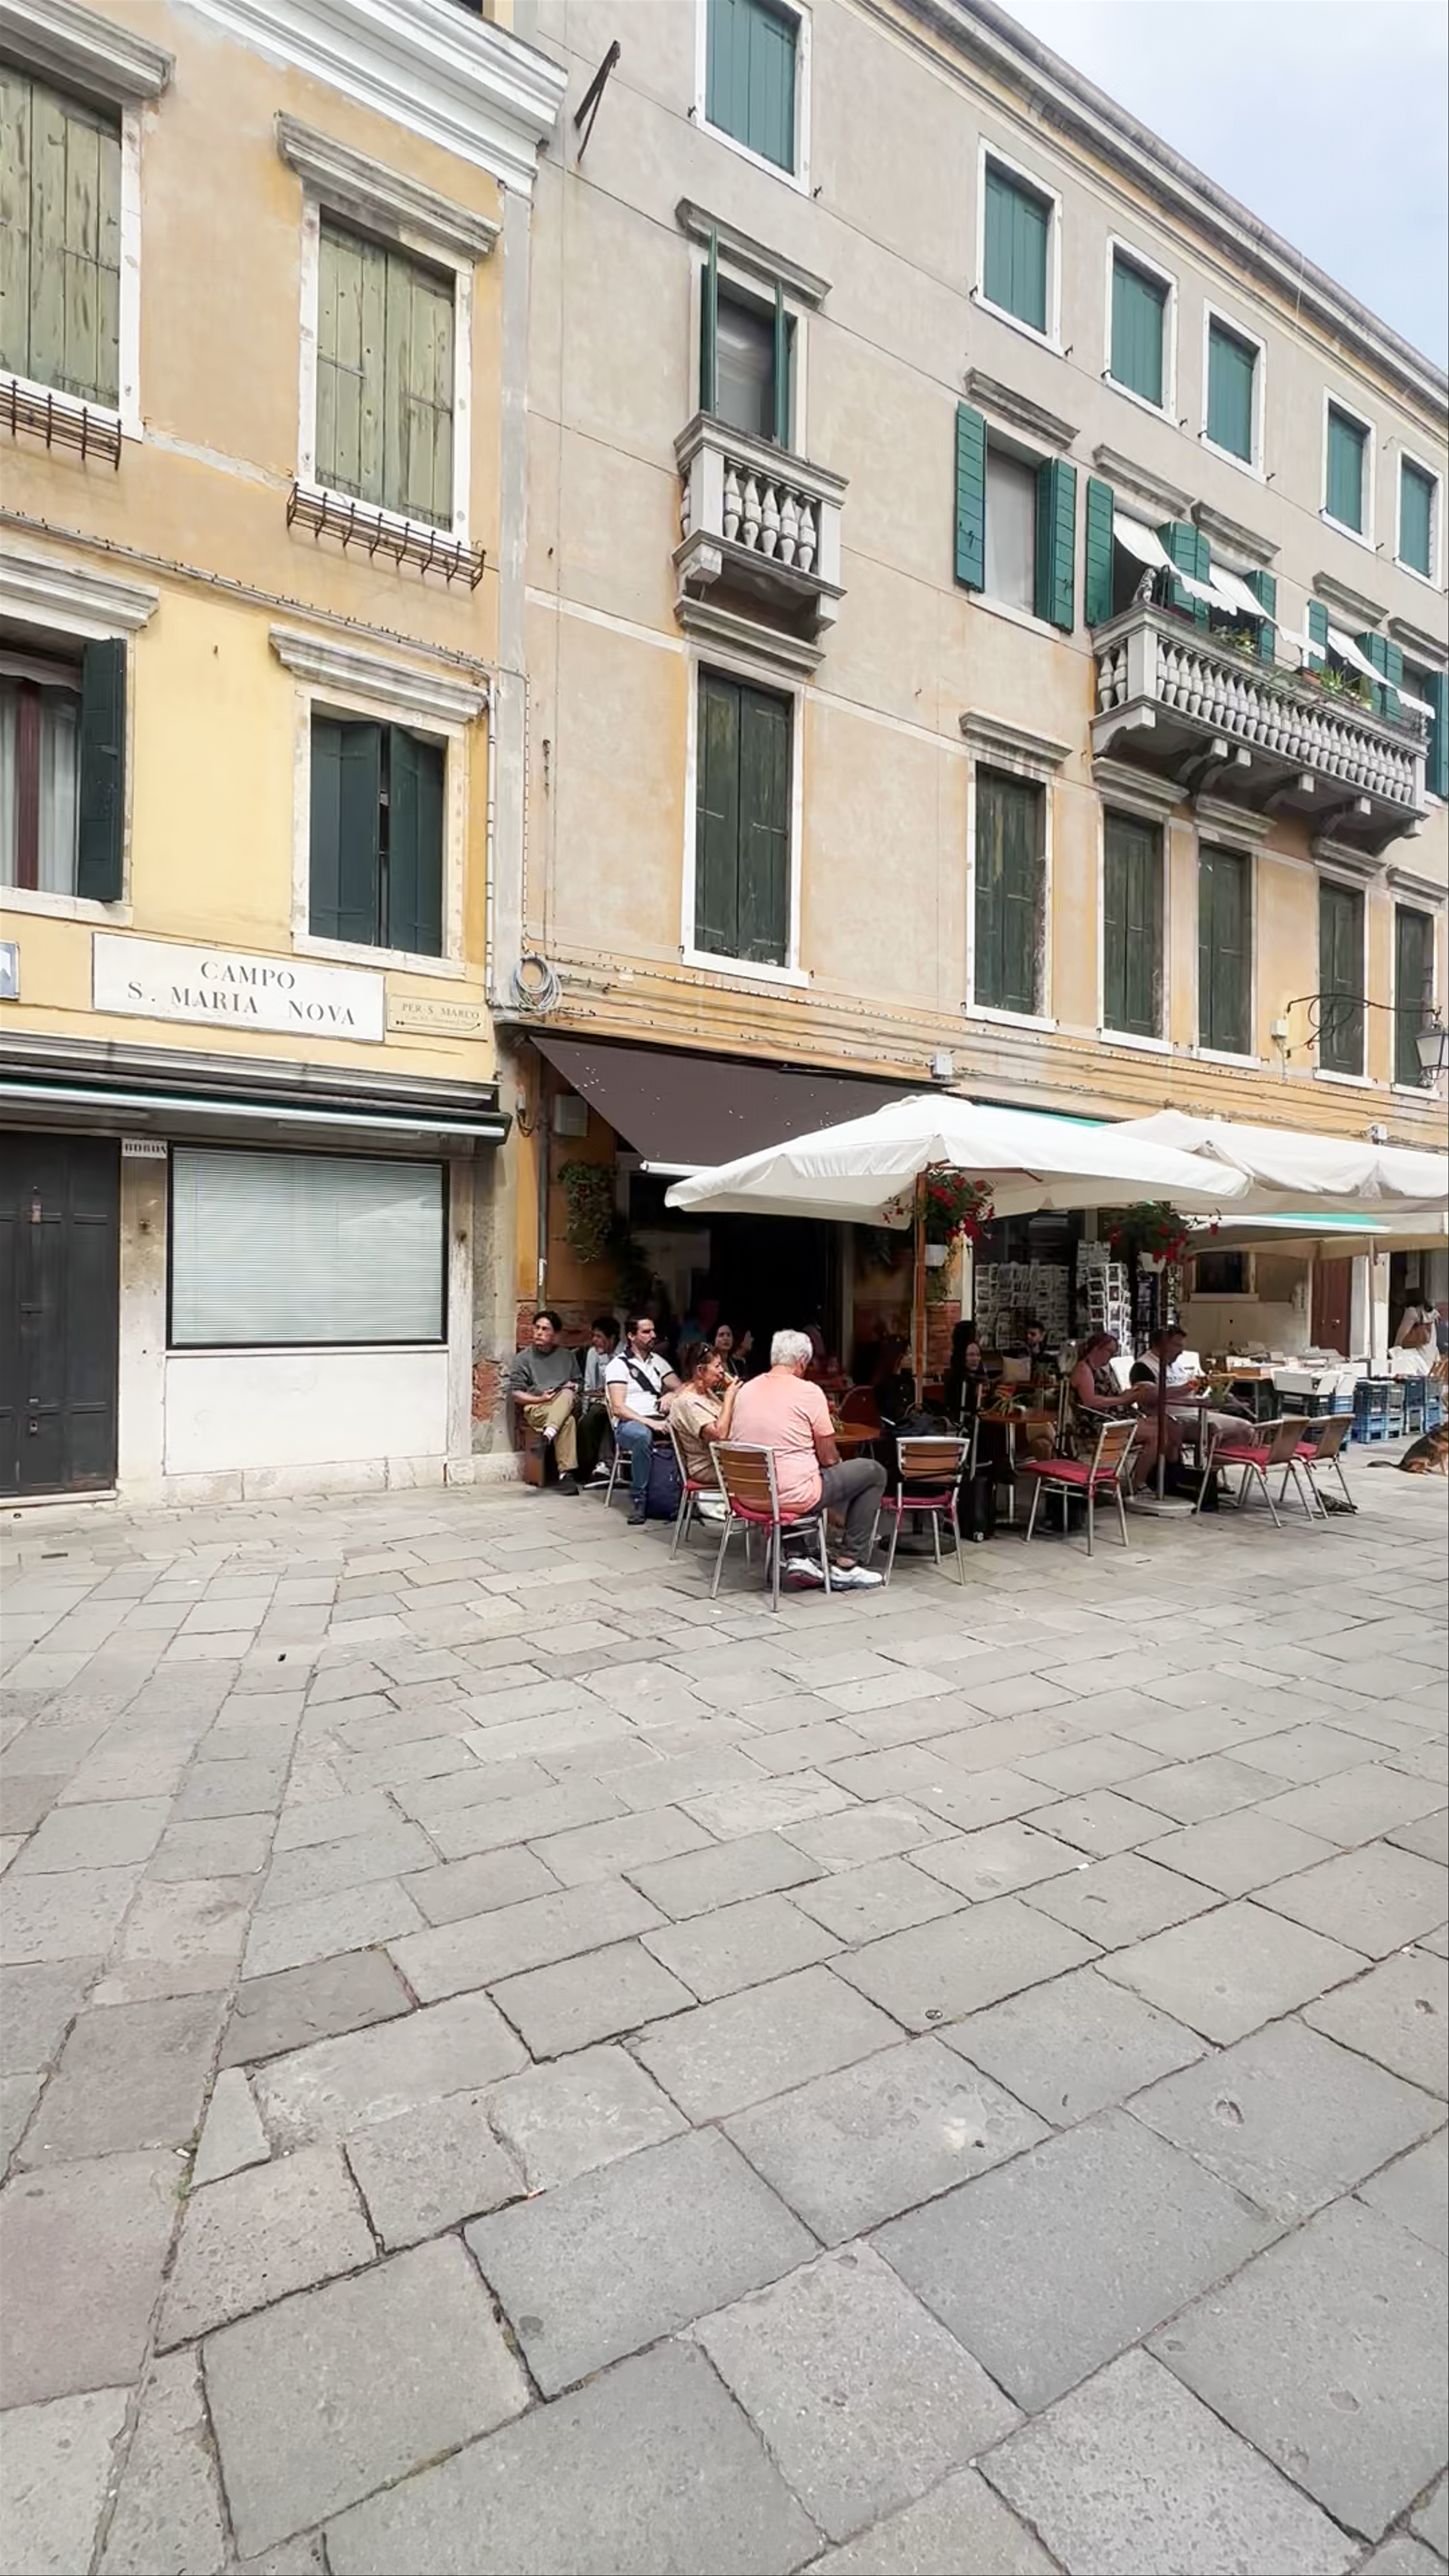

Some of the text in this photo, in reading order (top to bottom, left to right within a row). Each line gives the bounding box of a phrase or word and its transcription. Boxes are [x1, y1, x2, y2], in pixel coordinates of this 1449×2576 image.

[201, 961, 295, 989] CAMPO
[128, 981, 355, 1025] S. MARIA NOVA
[402, 1003, 421, 1012] PER
[441, 1007, 480, 1020] MARCO
